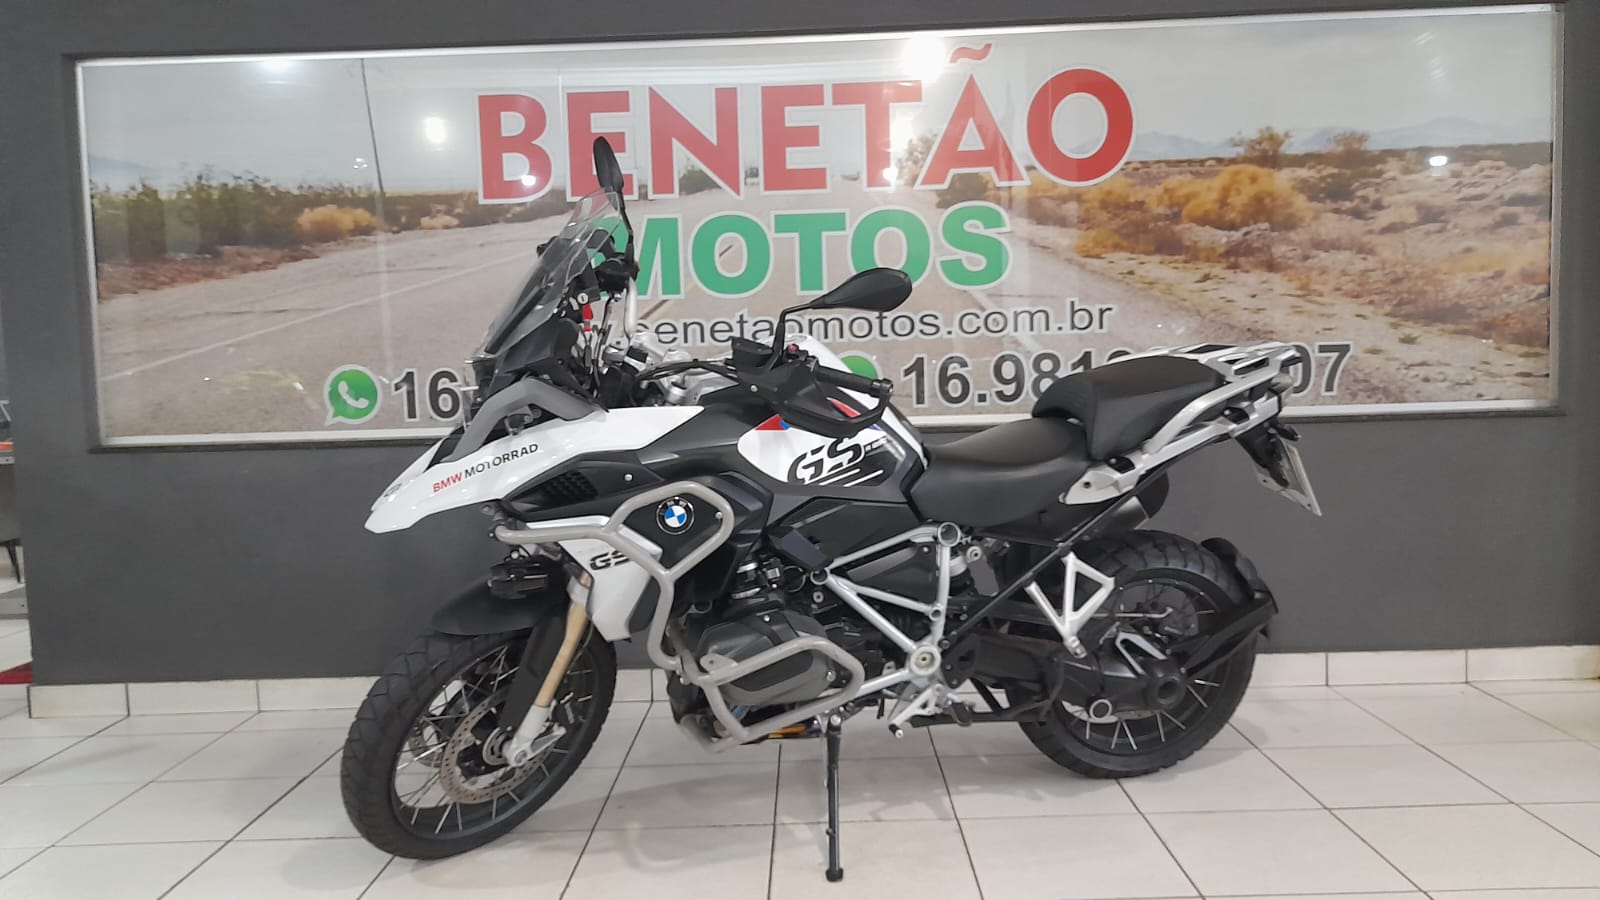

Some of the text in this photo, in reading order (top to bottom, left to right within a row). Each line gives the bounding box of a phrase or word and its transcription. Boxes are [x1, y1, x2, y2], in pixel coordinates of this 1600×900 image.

[477, 42, 1133, 201] BENETÃO
[590, 203, 1010, 298] MOTOS
[432, 471, 463, 493] BMW
[464, 443, 539, 479] MOTORRAD
[787, 436, 863, 484] GS
